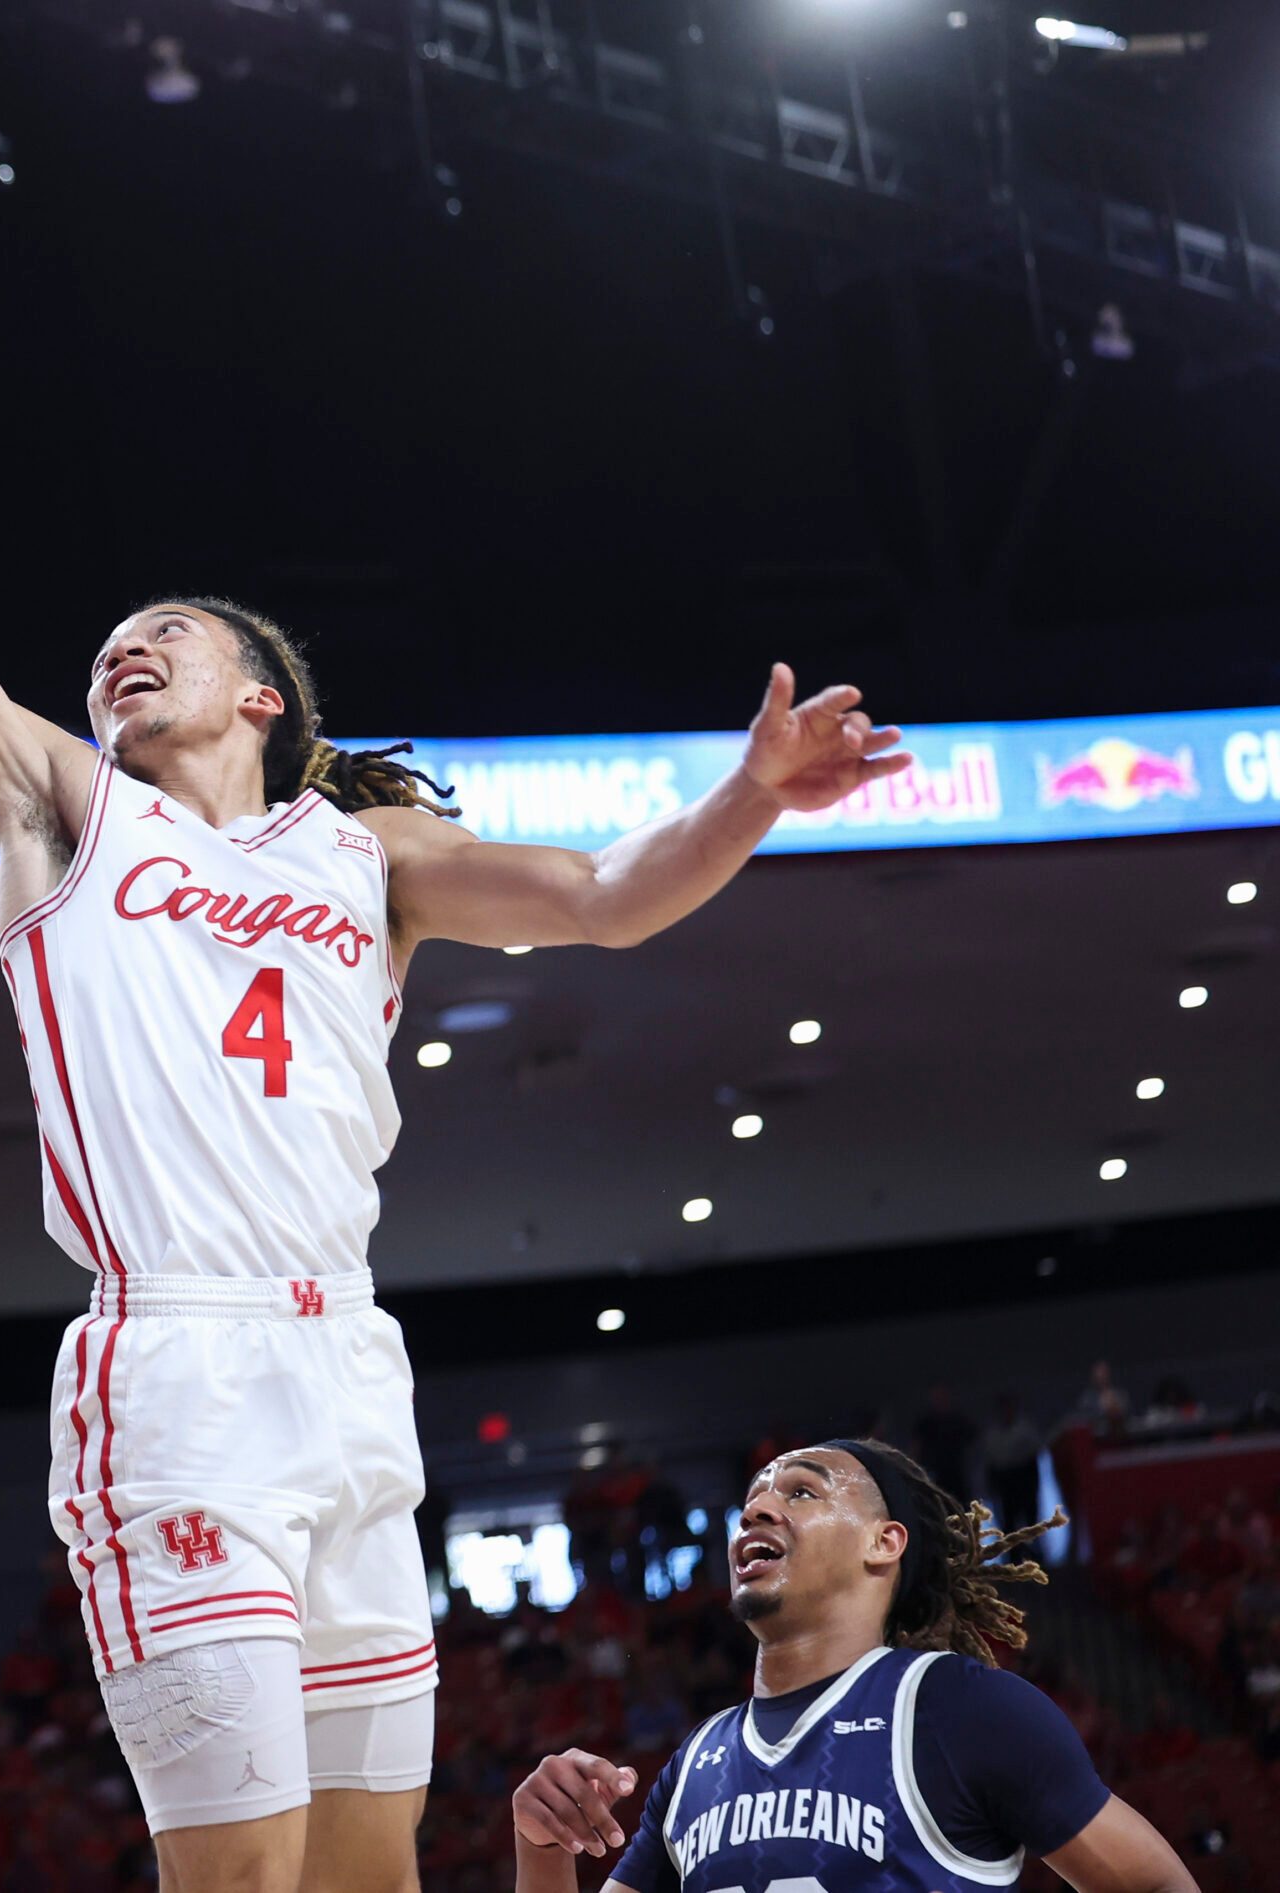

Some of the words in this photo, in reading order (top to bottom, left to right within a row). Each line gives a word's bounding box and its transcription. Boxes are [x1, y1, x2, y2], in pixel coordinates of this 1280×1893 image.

[883, 743, 1001, 825] Bull
[114, 856, 374, 968] Cougars
[221, 967, 293, 1098] 4
[832, 1717, 887, 1735] SLC
[729, 1788, 885, 1863] ORLEANS
